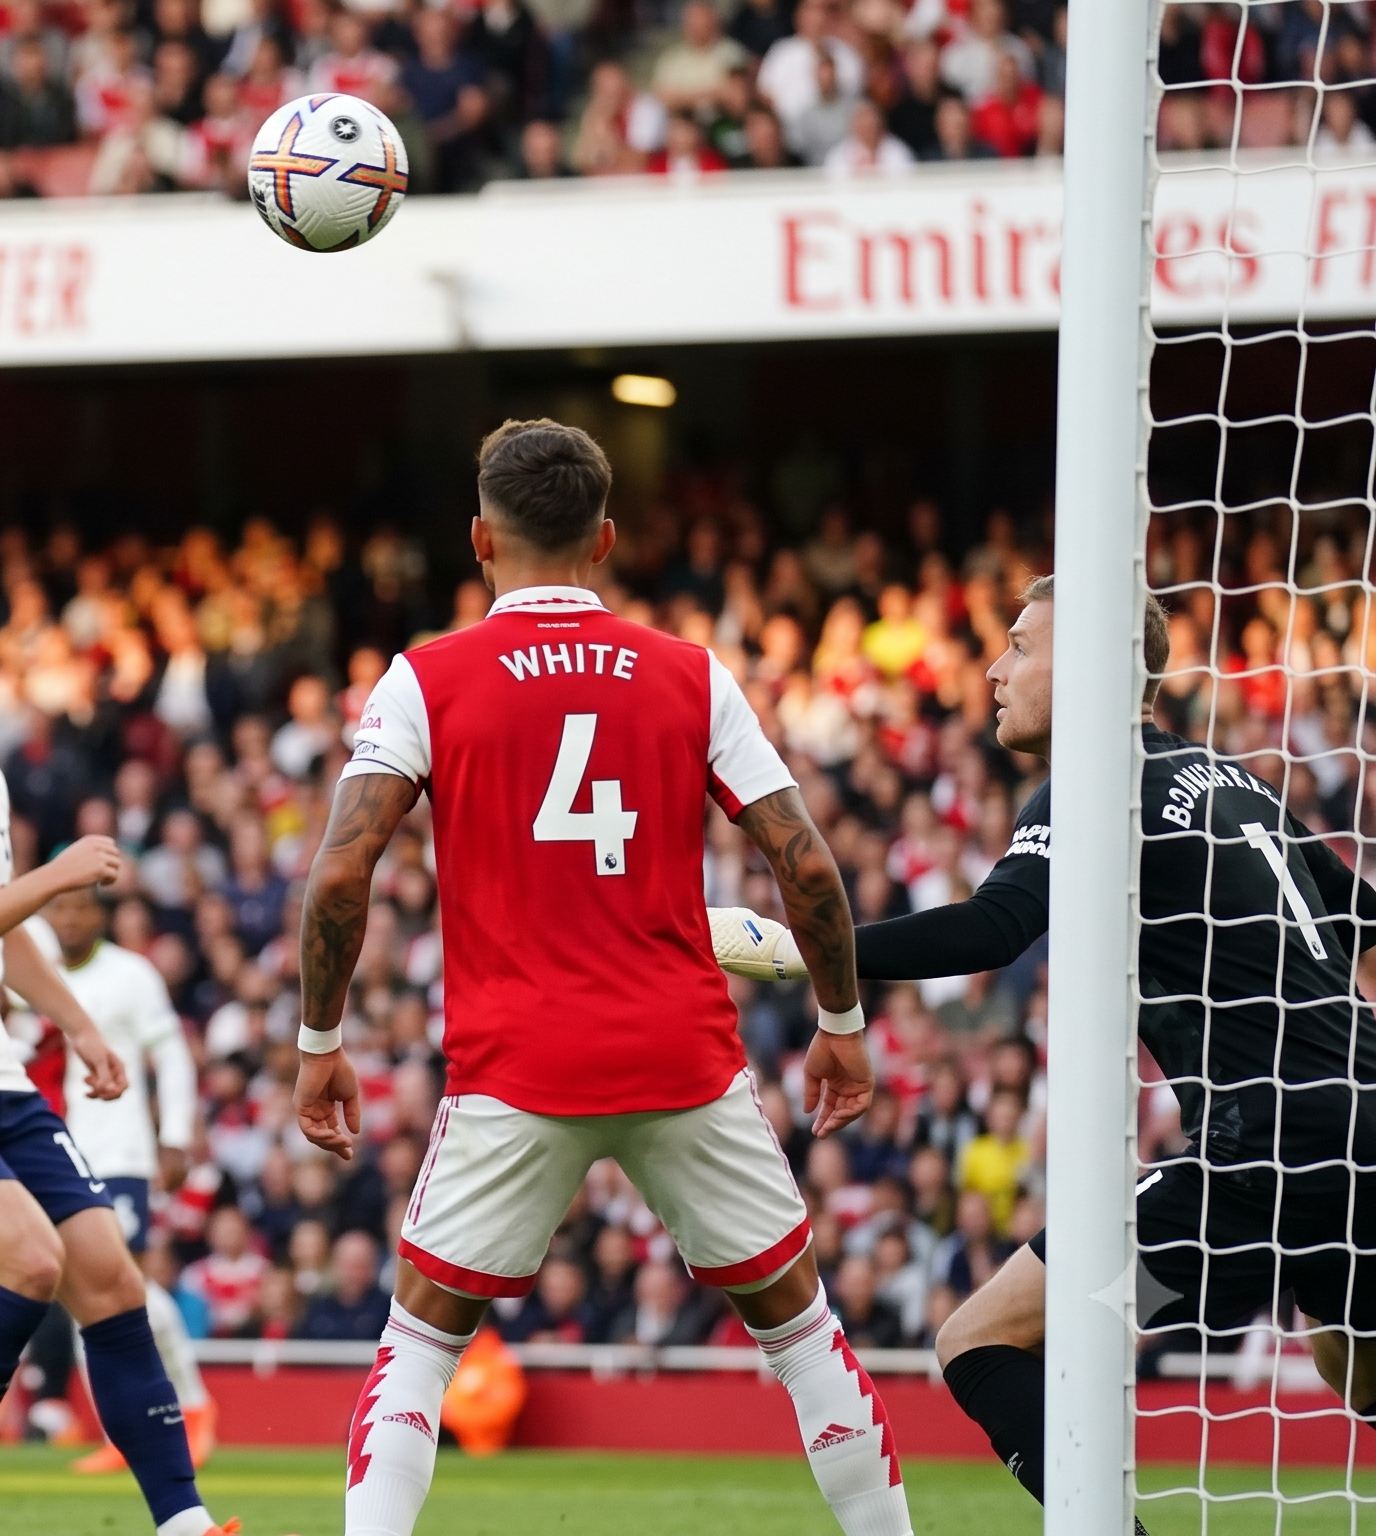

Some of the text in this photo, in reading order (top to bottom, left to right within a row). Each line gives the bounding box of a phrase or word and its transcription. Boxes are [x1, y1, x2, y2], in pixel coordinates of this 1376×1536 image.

[782, 201, 1262, 311] Emires
[499, 643, 638, 681] WHITE
[532, 713, 638, 876] 4
[1239, 822, 1328, 960] 1
